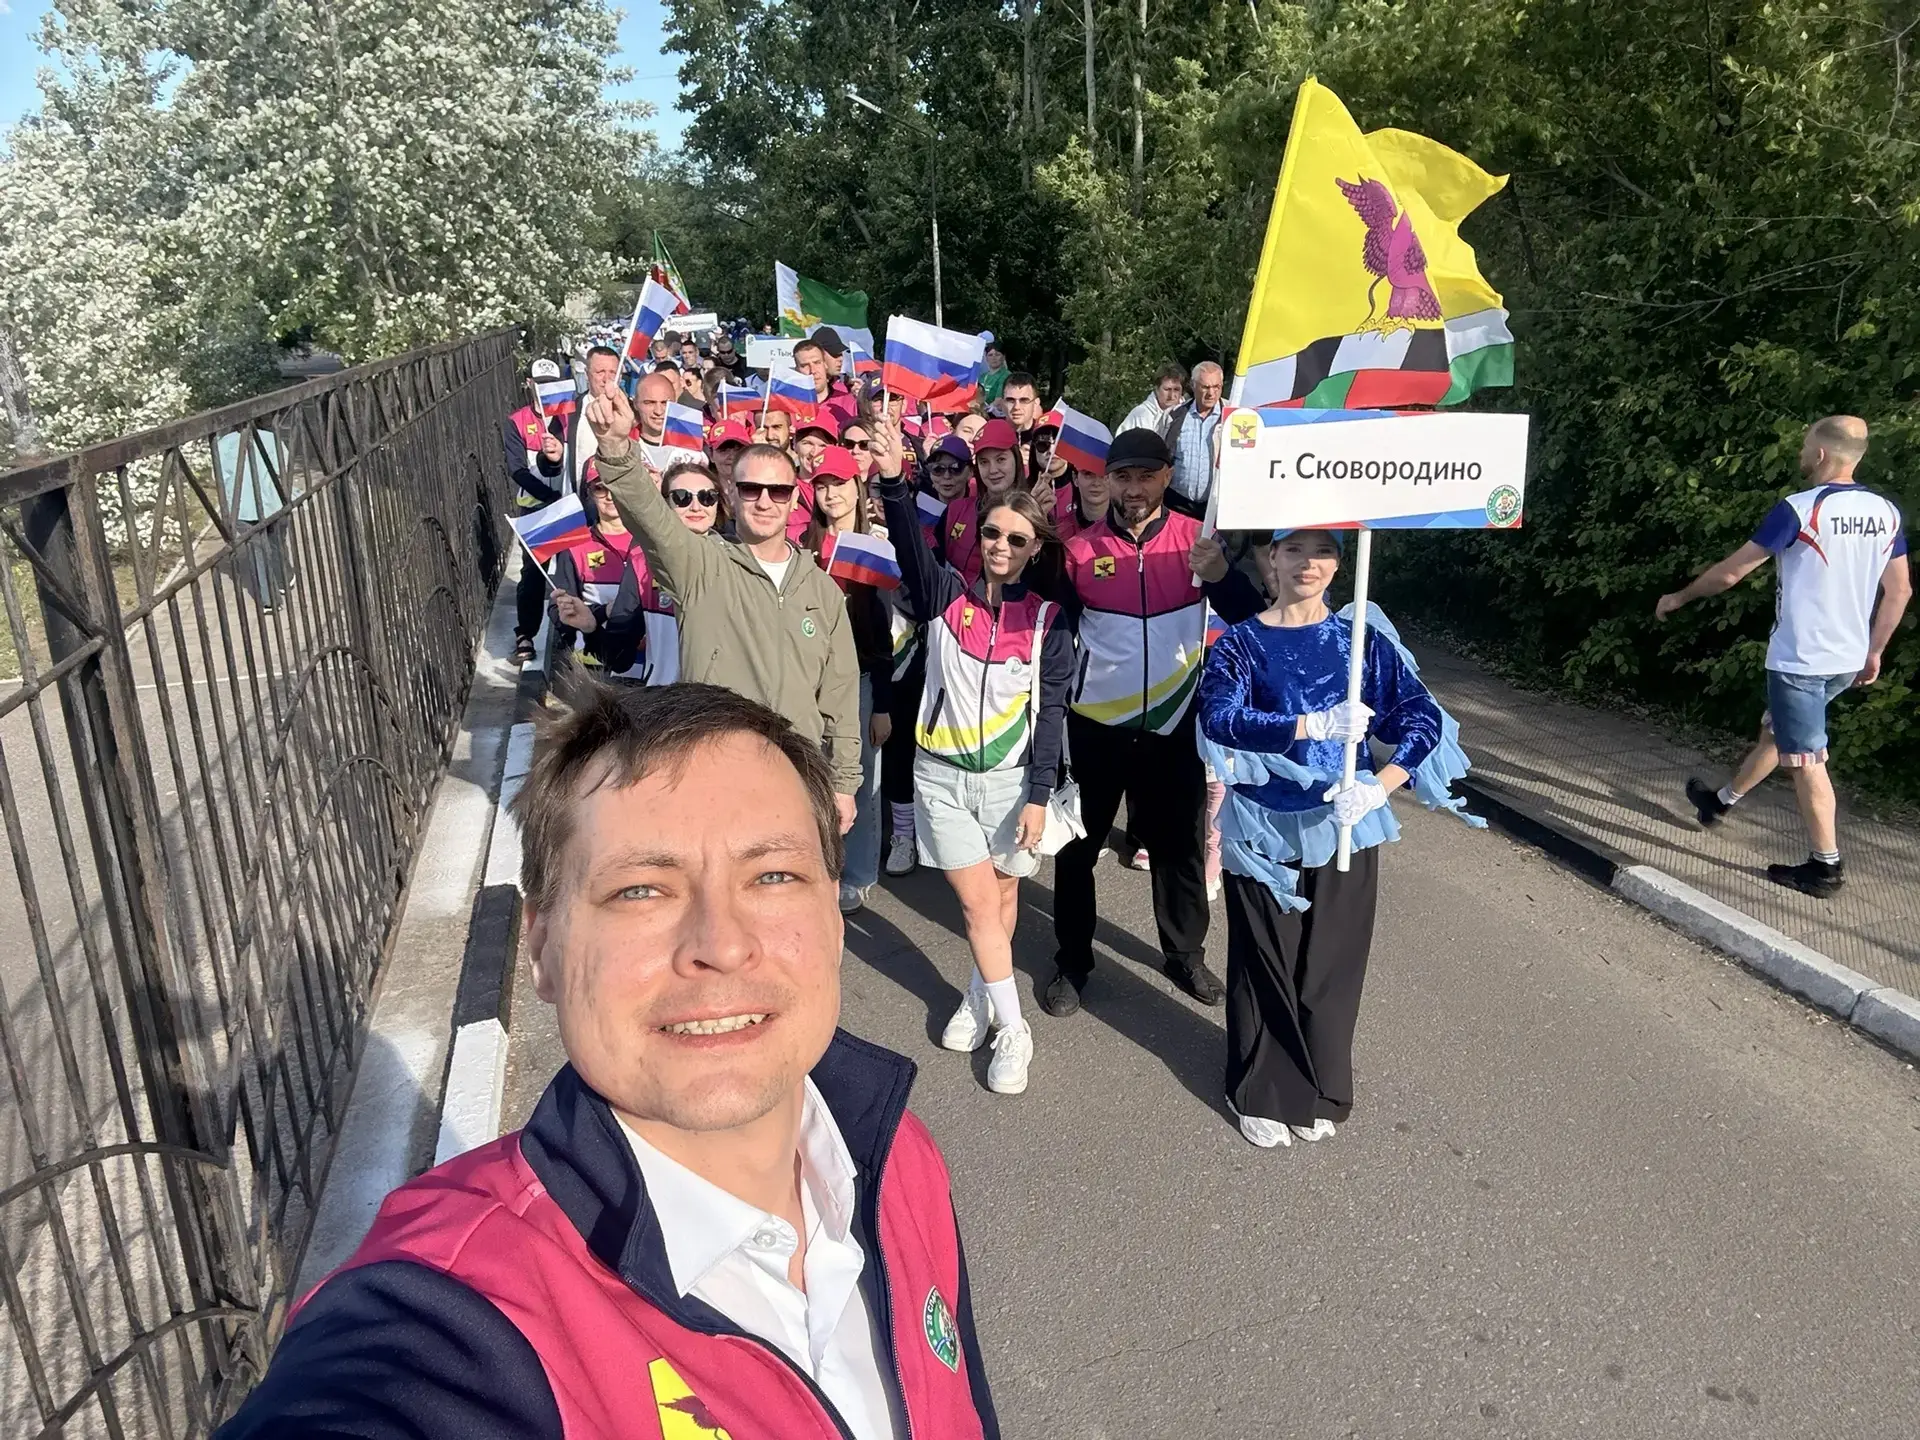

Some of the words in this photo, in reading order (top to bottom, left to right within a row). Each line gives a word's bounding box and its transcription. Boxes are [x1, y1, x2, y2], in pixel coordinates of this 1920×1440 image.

[777, 348, 794, 357] Тын
[1269, 459, 1286, 479] г.
[1296, 452, 1482, 486] Сковородино
[1830, 516, 1887, 537] ТЫНДА
